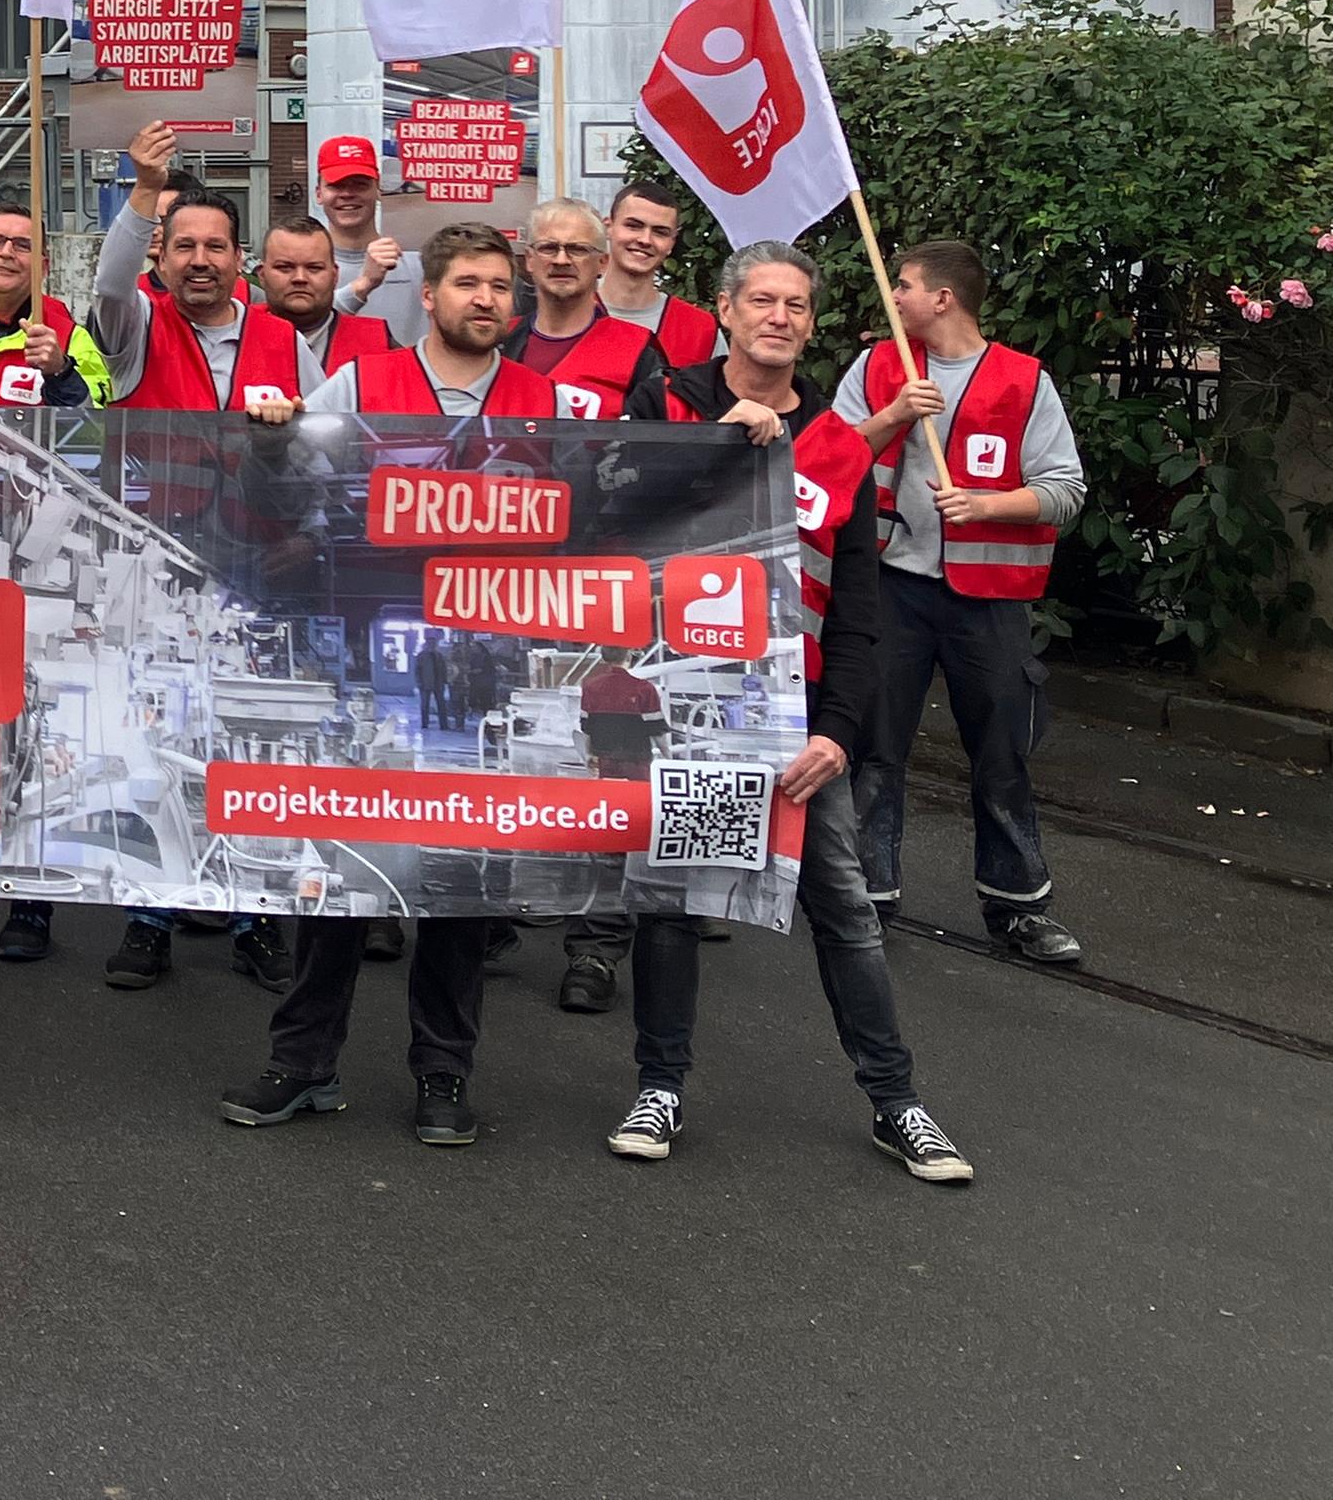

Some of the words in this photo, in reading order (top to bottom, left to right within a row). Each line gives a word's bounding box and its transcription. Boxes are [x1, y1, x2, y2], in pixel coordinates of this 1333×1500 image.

[93, 0, 162, 17] ENERGIE
[168, 0, 220, 17] JETZT
[97, 22, 192, 41] STANDORTE
[198, 22, 233, 41] UND
[100, 42, 228, 64] ARBEITSPLÄTZE
[129, 69, 196, 87] RETTEN!
[416, 103, 505, 120] BEZAHLBARE
[400, 123, 459, 139] ENERGIE
[463, 124, 506, 140] JETZT
[403, 143, 484, 160] STANDORTE
[488, 145, 518, 160] UND
[405, 161, 514, 180] ARBEITSPLÄTZE
[430, 184, 488, 199] RETTEN!
[383, 477, 562, 535] PROJEKT
[434, 567, 633, 633] ZUKUNFT
[683, 627, 745, 649] IGBCE
[223, 785, 629, 833] projektzukunft.igbce.de
